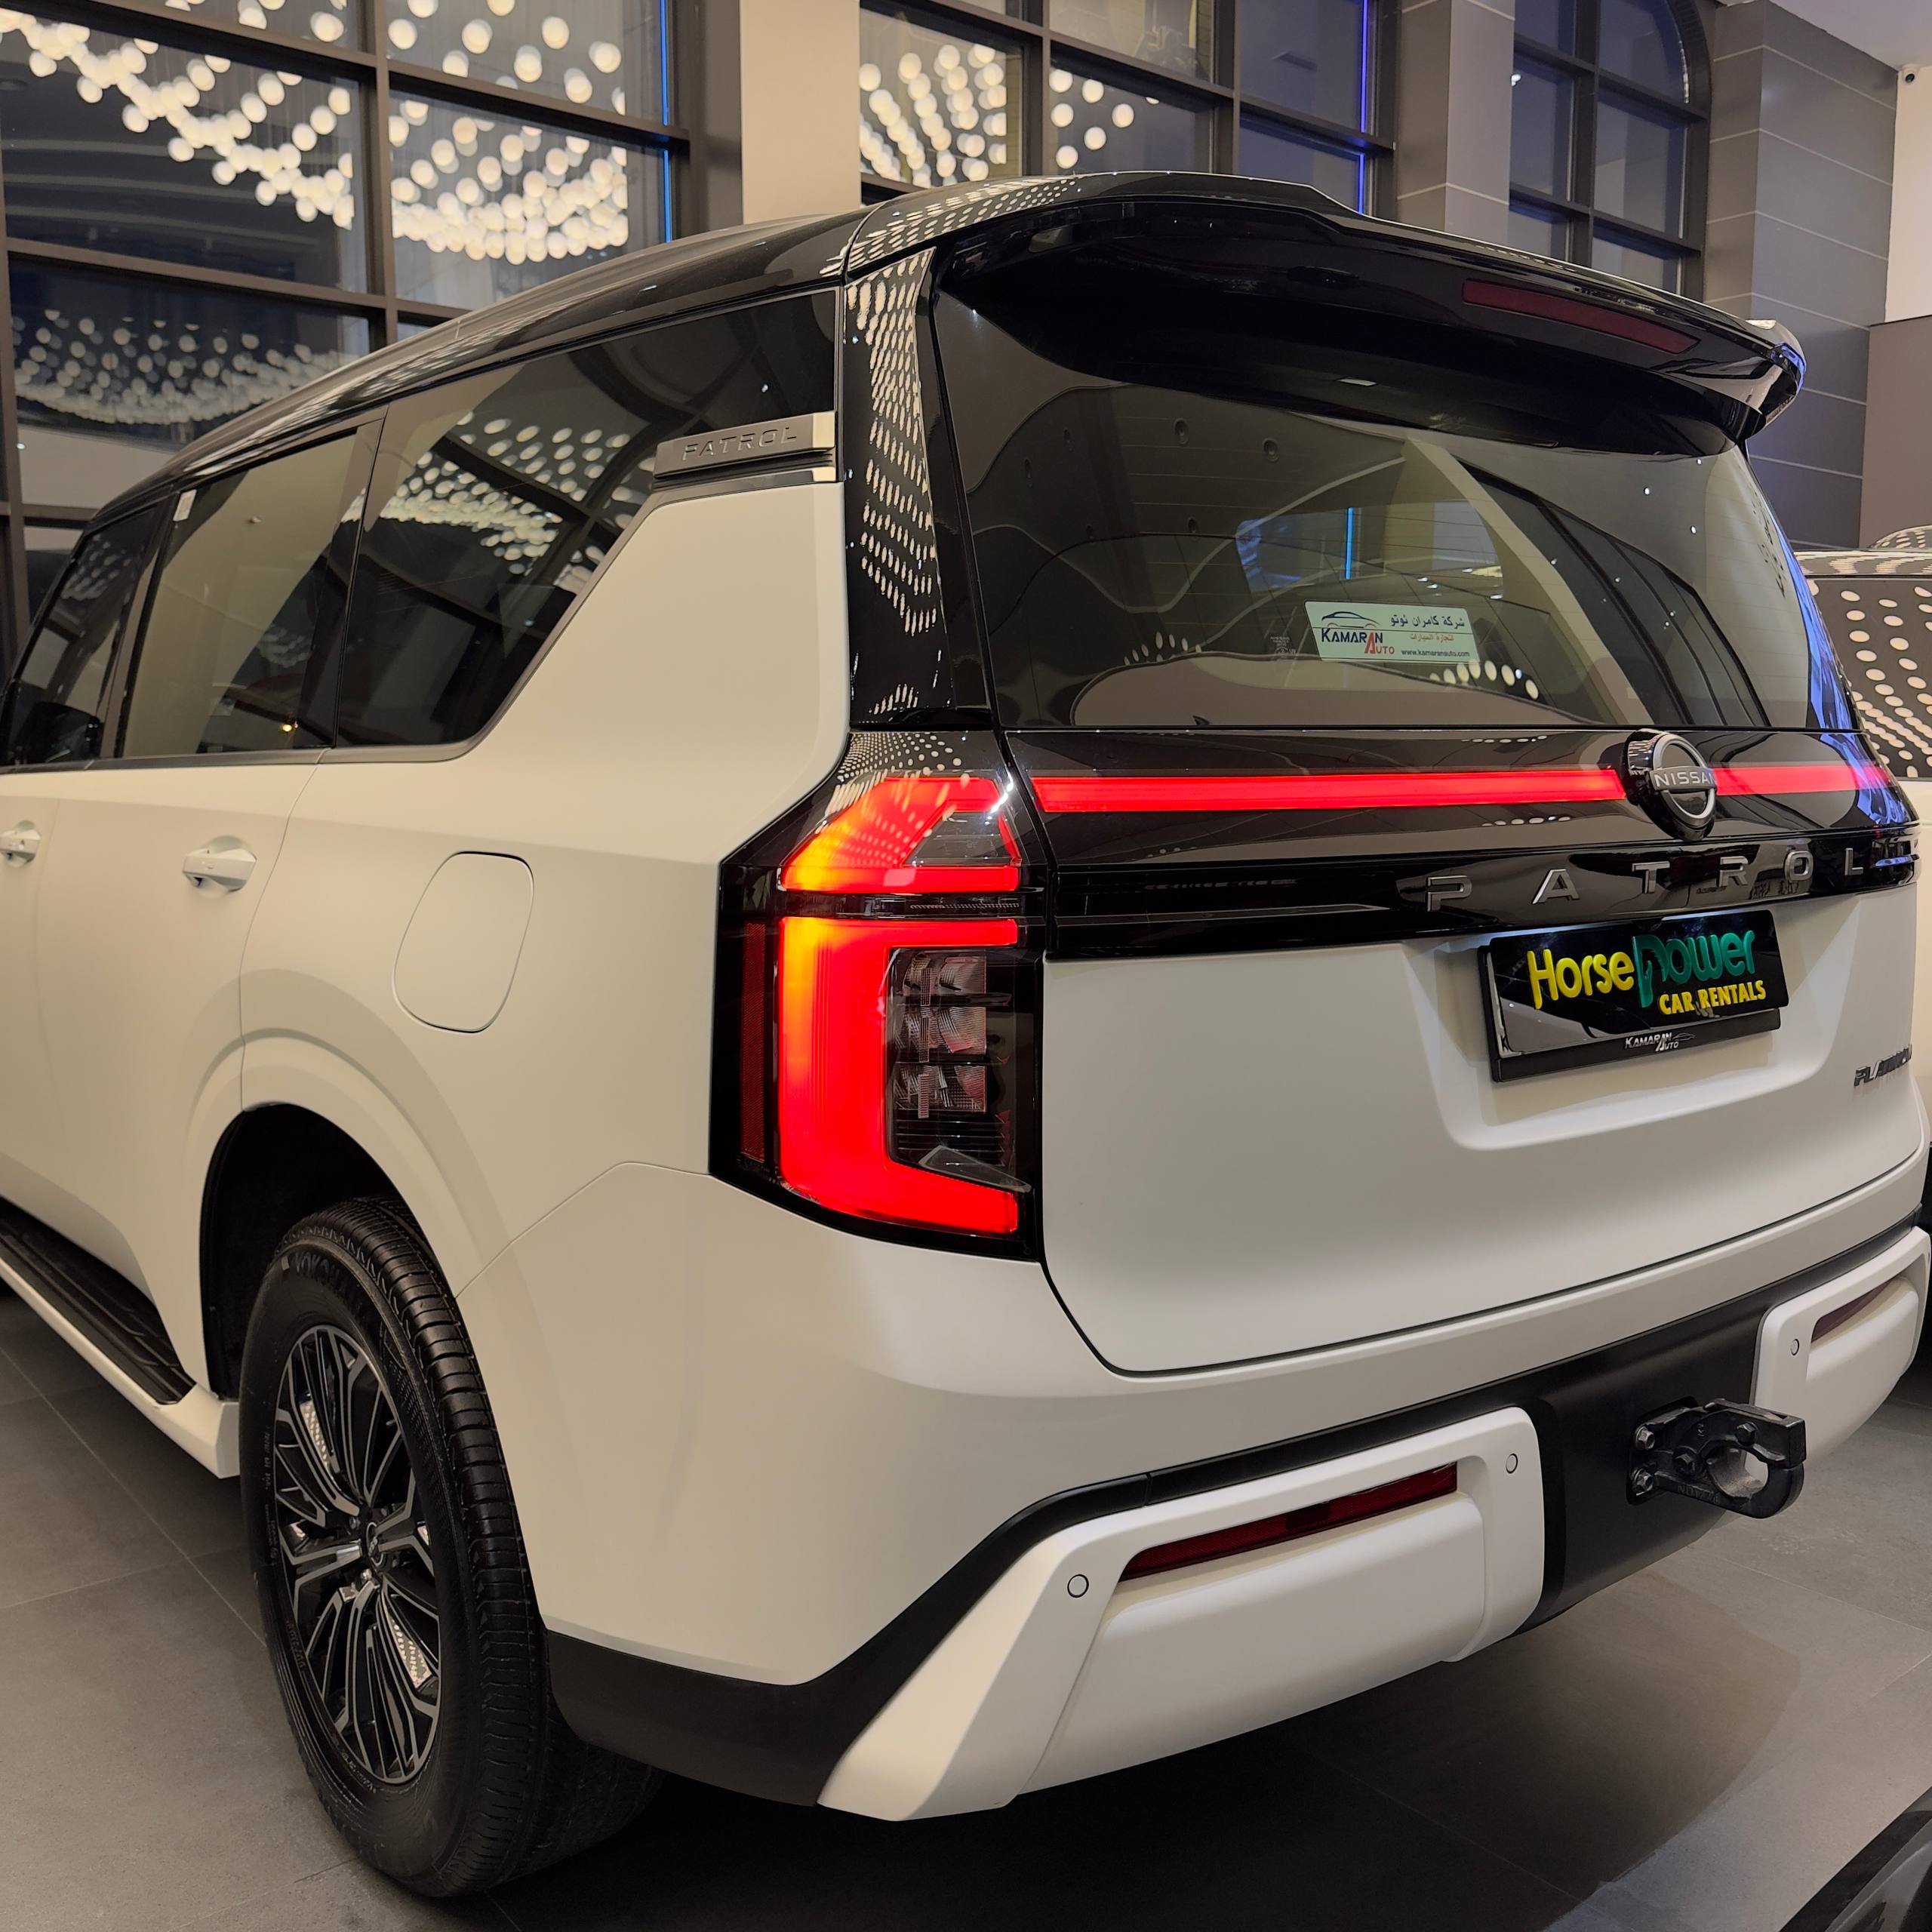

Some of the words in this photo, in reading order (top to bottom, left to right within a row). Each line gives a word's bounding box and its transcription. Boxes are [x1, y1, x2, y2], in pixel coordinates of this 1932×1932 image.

[681, 426, 797, 461] PATROL
[1412, 615, 1439, 628] كامران
[1442, 615, 1465, 629] شركة
[1321, 627, 1383, 645] KAMARAN
[1364, 635, 1395, 654] AUTO
[1401, 648, 1470, 657] www.kamaranauto.com
[1426, 847, 1864, 912] PATROL
[1659, 990, 1695, 1015] CAR
[1697, 980, 1767, 1010] RENTALS
[1625, 1032, 1672, 1050] KAMARAN
[1655, 1039, 1679, 1052] AUTO
